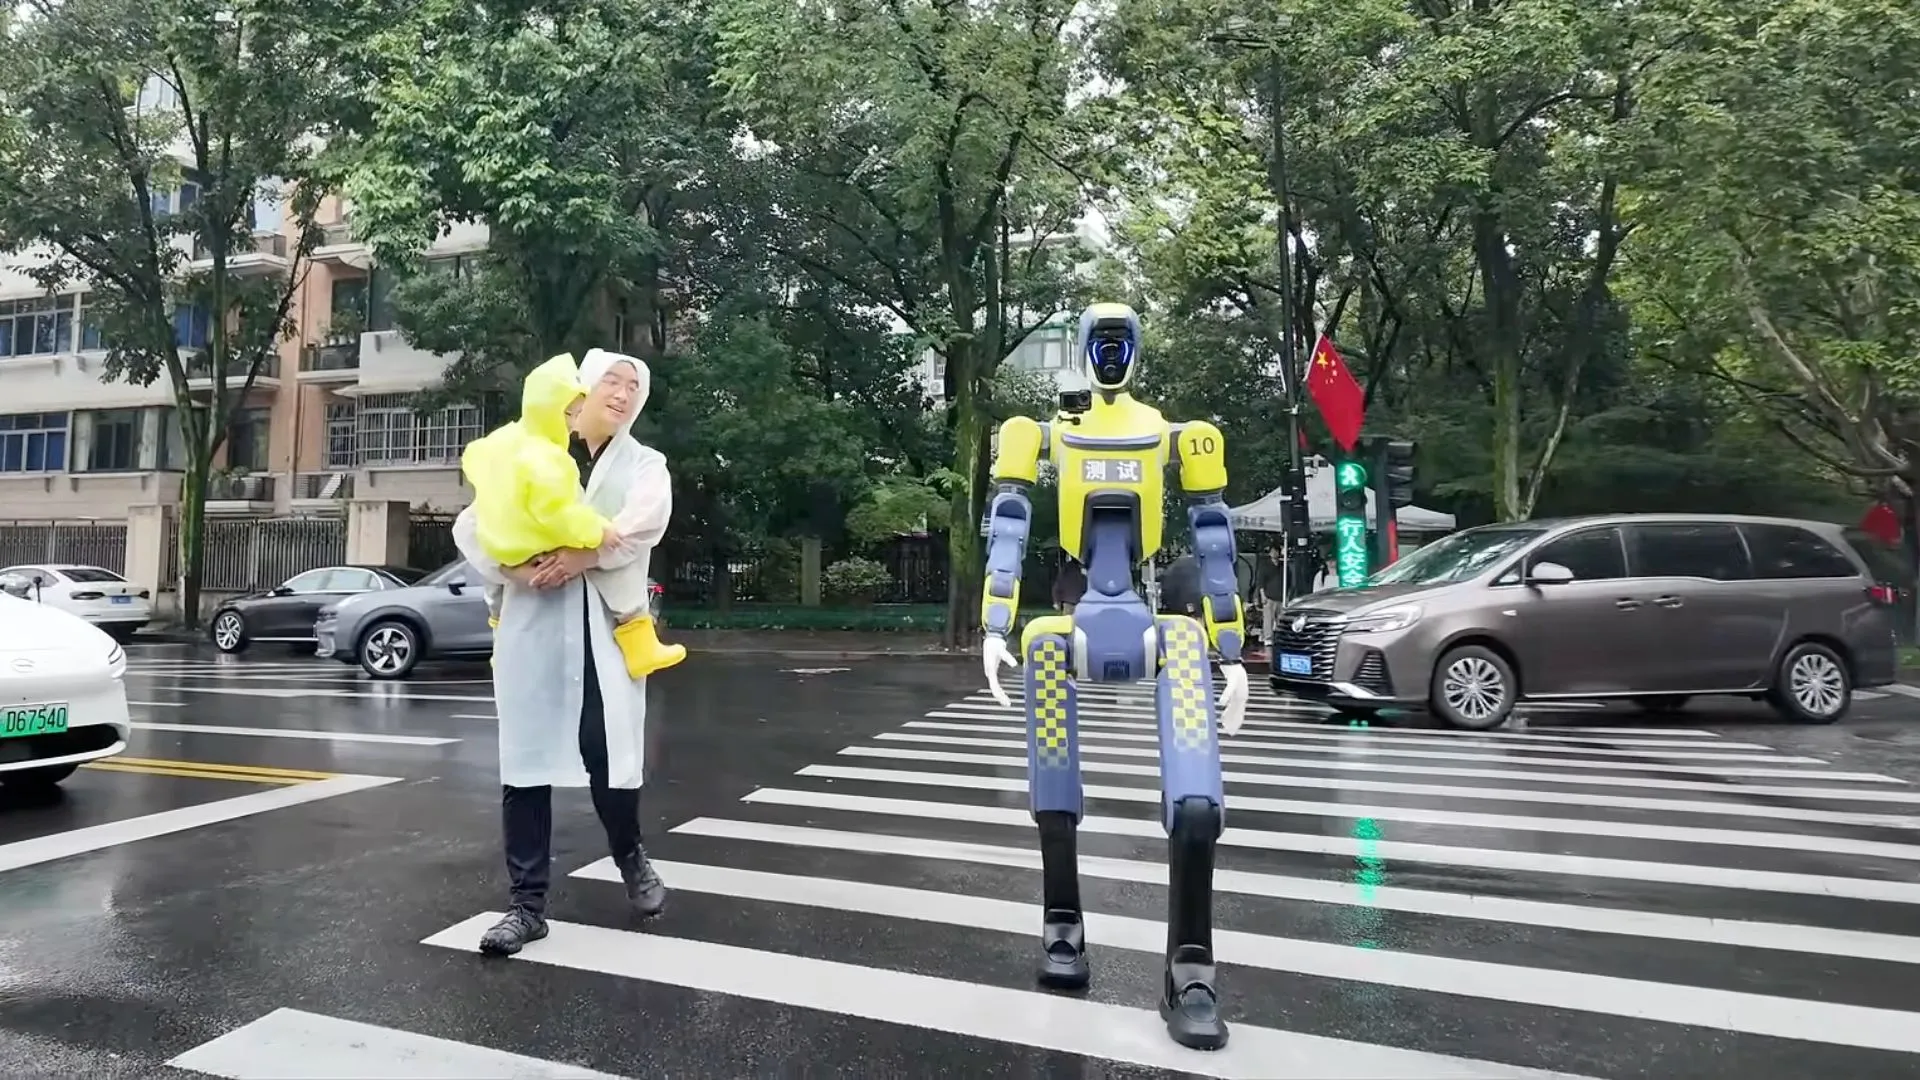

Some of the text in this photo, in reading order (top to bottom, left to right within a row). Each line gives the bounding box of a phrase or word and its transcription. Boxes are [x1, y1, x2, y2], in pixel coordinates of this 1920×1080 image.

[1190, 437, 1214, 455] 10
[1086, 460, 1138, 480] 测试
[6, 707, 66, 732] D67540
